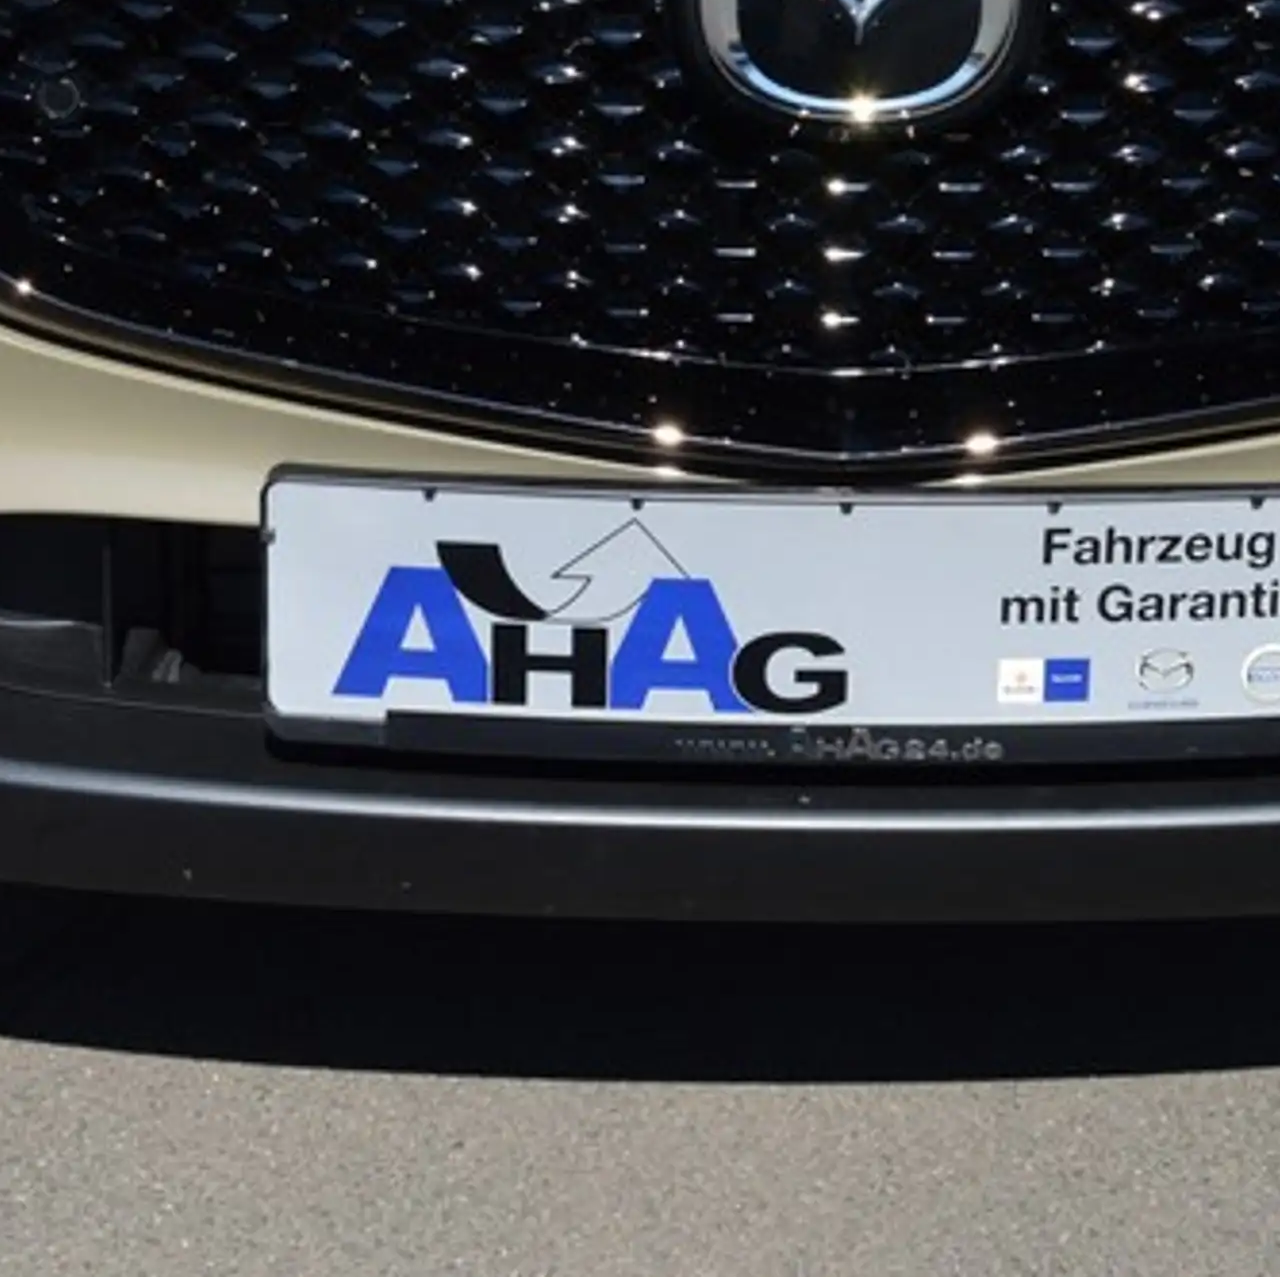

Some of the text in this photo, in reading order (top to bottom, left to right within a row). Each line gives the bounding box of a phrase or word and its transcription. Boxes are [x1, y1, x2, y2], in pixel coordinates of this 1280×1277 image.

[1043, 526, 1277, 568] Fahrzeug
[1000, 585, 1081, 624] mit
[332, 566, 849, 714] AHAG
